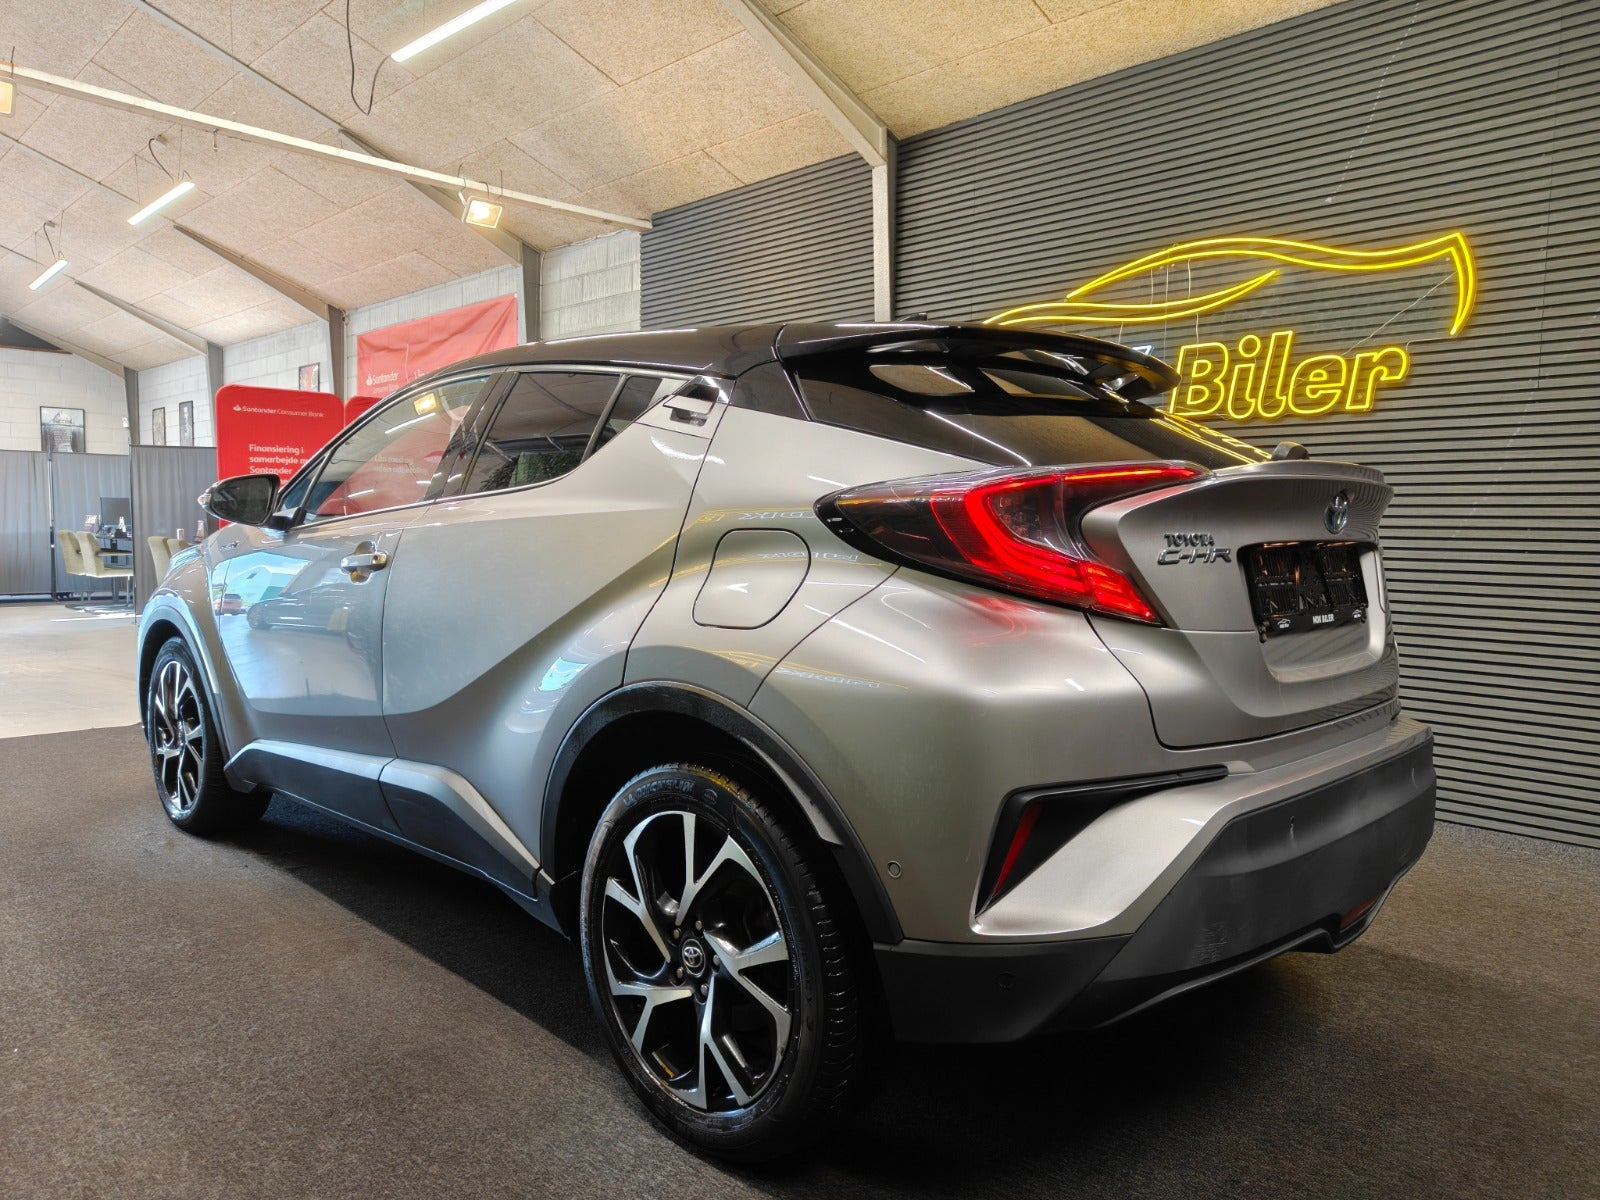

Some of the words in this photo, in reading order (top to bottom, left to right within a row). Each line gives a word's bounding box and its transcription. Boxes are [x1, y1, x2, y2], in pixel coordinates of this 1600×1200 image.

[1169, 329, 1410, 420] Biler
[242, 405, 276, 414] Santander
[249, 444, 300, 456] Finansiering
[249, 456, 299, 466] samarbejde
[249, 465, 292, 475] Santander
[1164, 533, 1215, 547] TOYOTA
[1157, 548, 1232, 565] C-HR
